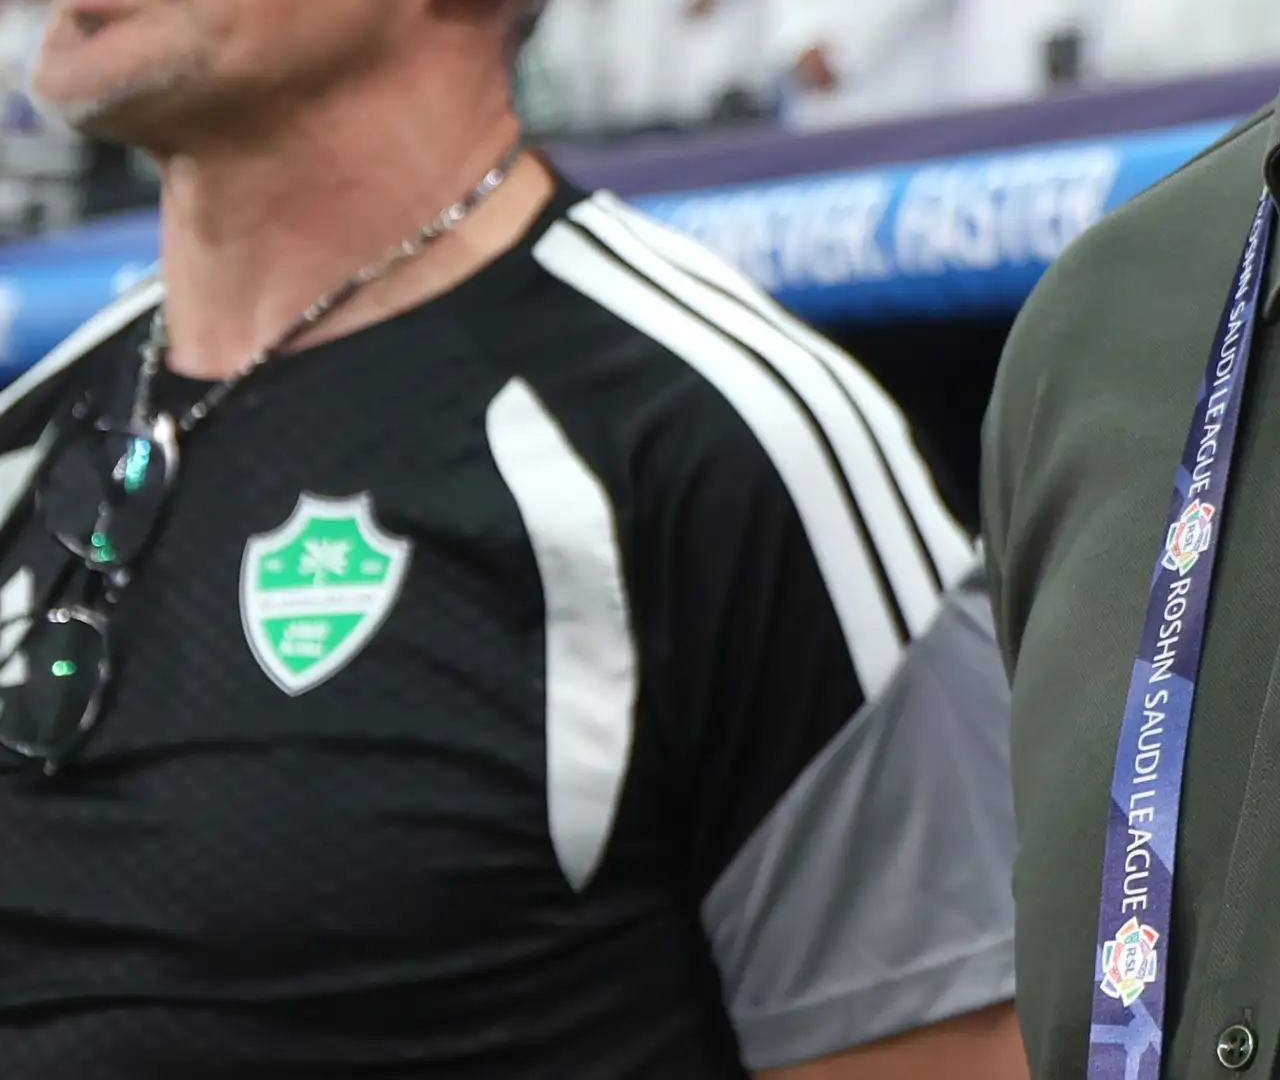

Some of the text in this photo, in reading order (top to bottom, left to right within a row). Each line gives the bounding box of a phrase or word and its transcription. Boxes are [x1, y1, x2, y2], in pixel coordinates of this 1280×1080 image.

[1213, 301, 1246, 388] SAUDI
[1188, 385, 1227, 495] LEAGUE
[1122, 578, 1192, 914] ROSHN SAUDI LEAGUE
[1125, 946, 1137, 977] RSL
